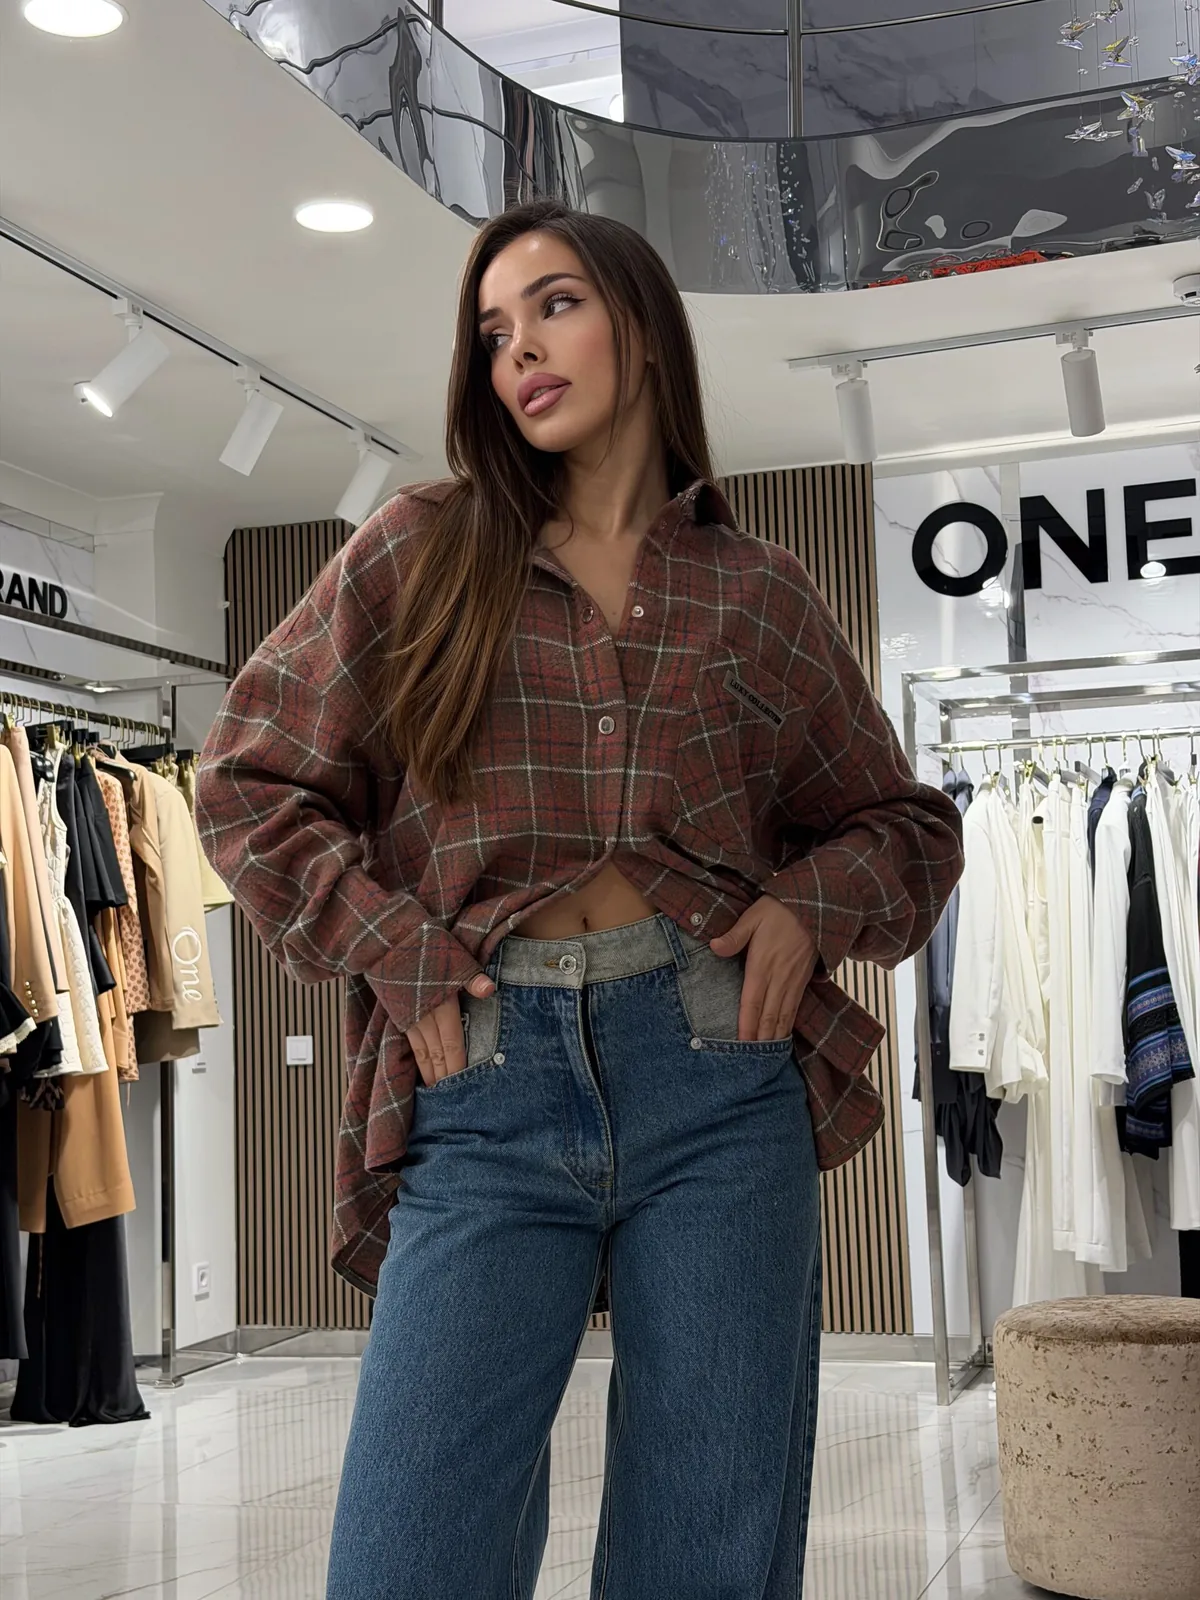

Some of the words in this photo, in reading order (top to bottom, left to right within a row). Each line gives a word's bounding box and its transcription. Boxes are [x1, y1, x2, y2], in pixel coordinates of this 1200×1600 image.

[912, 478, 1200, 597] ONE
[0, 569, 68, 619] AND
[172, 925, 203, 1004] One
